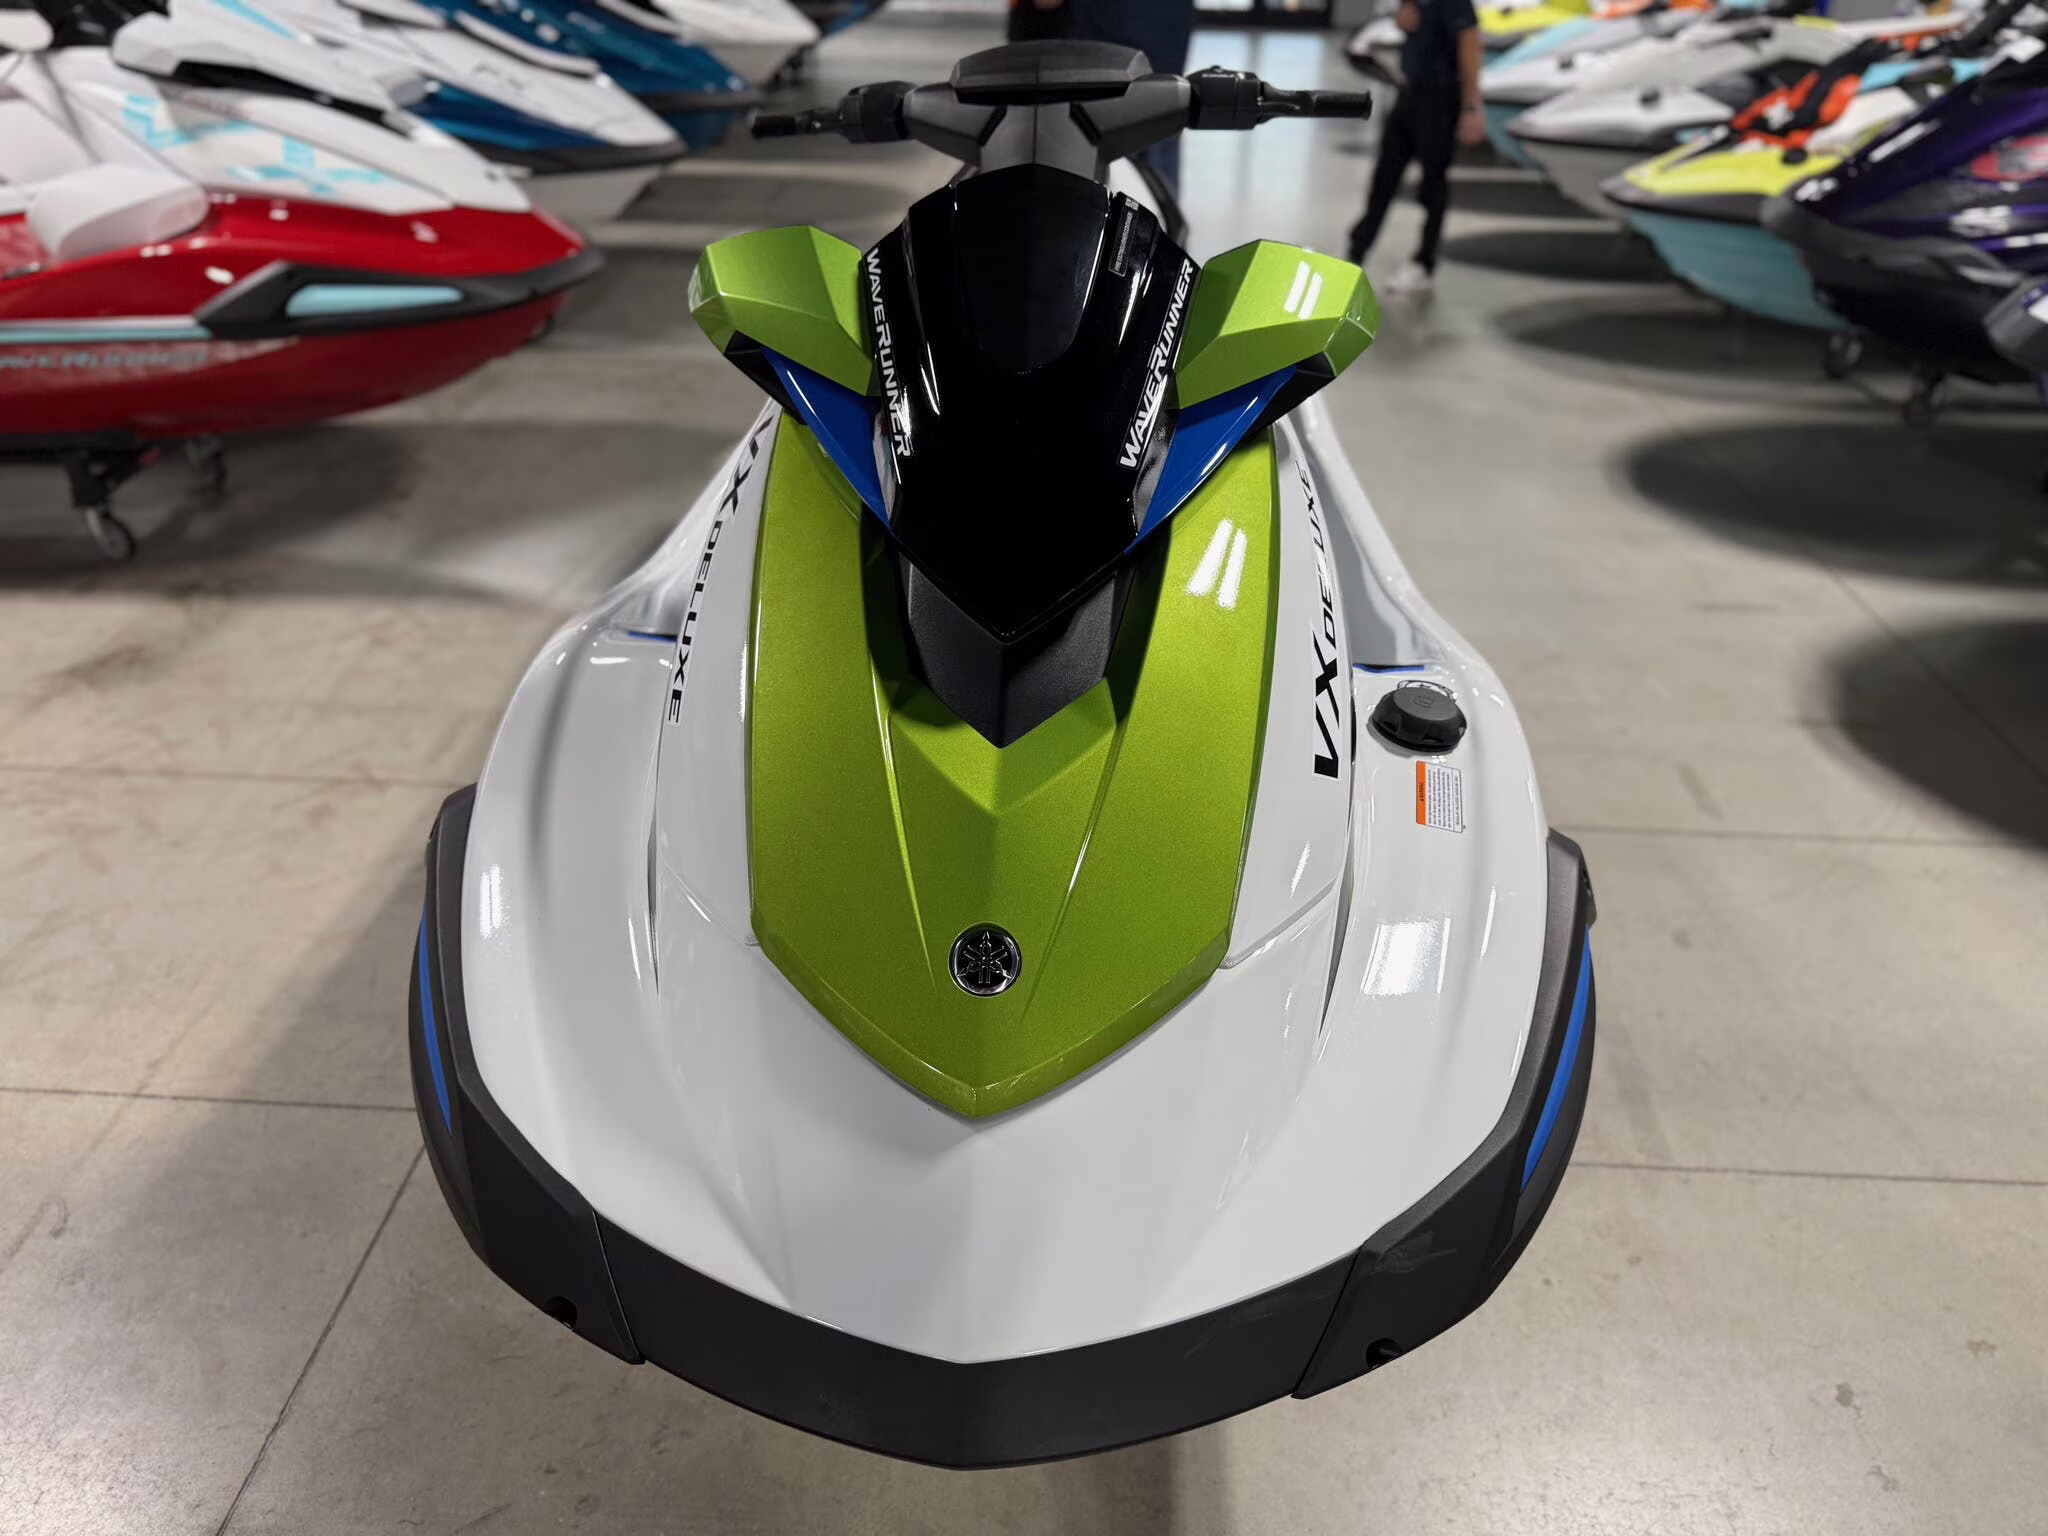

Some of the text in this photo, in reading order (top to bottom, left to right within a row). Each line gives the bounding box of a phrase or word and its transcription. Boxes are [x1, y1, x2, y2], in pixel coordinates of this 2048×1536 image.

[867, 248, 912, 457] WAVERUNNER
[1120, 258, 1193, 467] WAVERUNNER
[668, 415, 774, 723] VX DELUXE
[1313, 629, 1340, 779] VX
